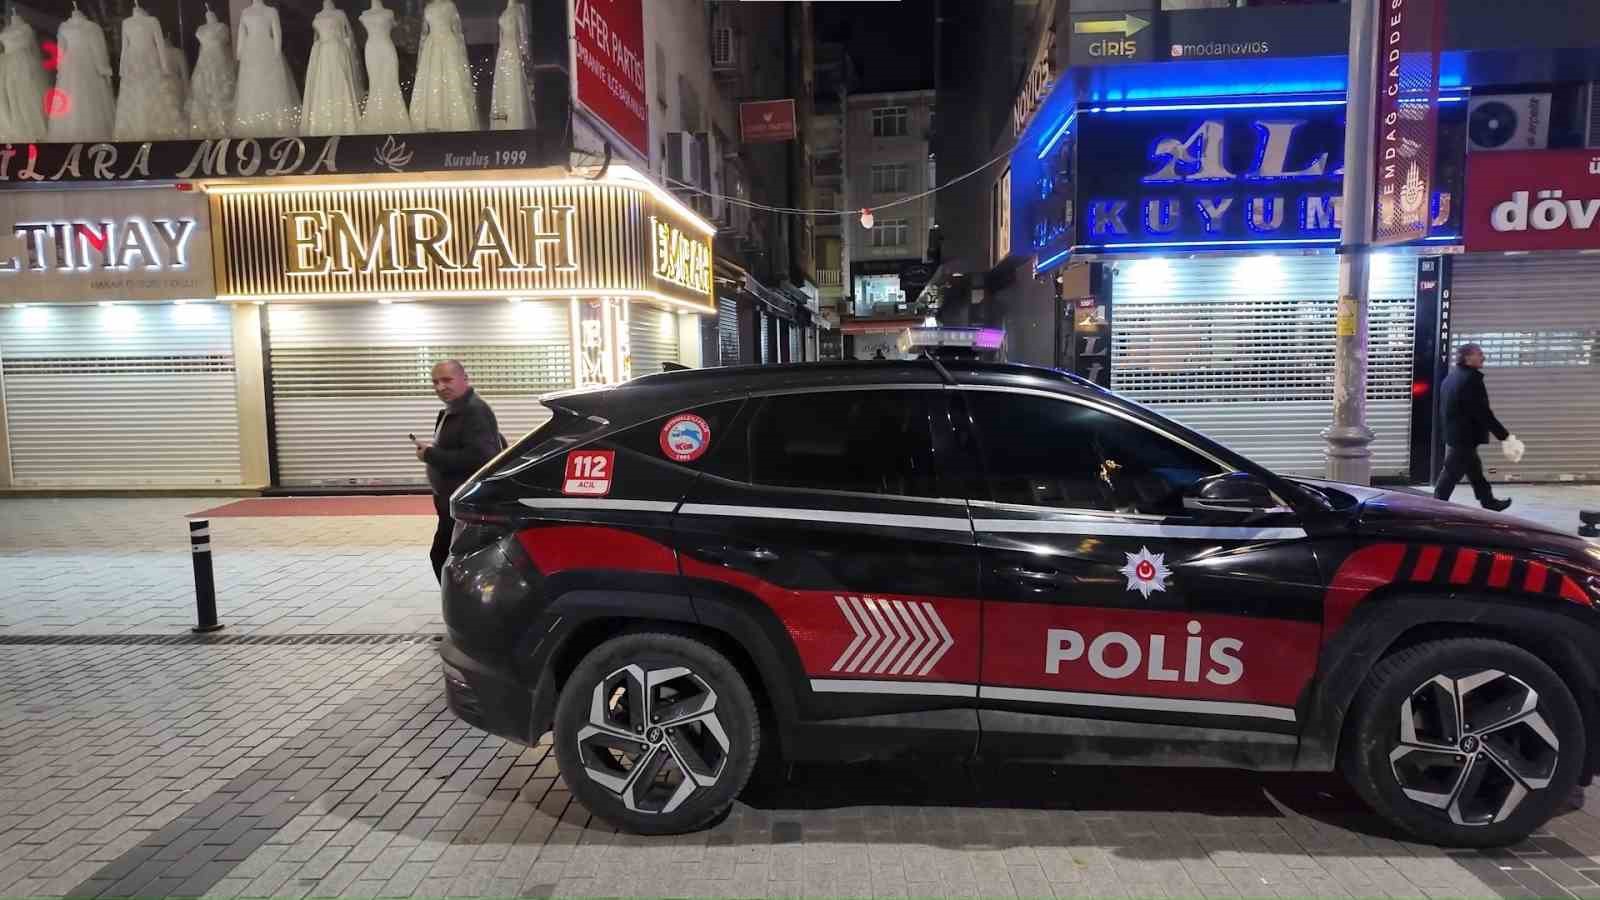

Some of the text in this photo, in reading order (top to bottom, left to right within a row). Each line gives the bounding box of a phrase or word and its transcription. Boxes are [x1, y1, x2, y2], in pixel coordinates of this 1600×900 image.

[574, 0, 611, 57] ZAFER
[1088, 39, 1137, 59] GİRİŞ
[175, 136, 342, 179] MODA
[443, 150, 527, 169] Kuruluş 1999
[1143, 118, 1345, 182] AL
[1090, 193, 1452, 236] KUYUMU
[282, 203, 578, 278] EMRAH
[648, 216, 712, 295] EMRAH
[574, 455, 607, 478] 112
[1045, 620, 1244, 685] POLİS
